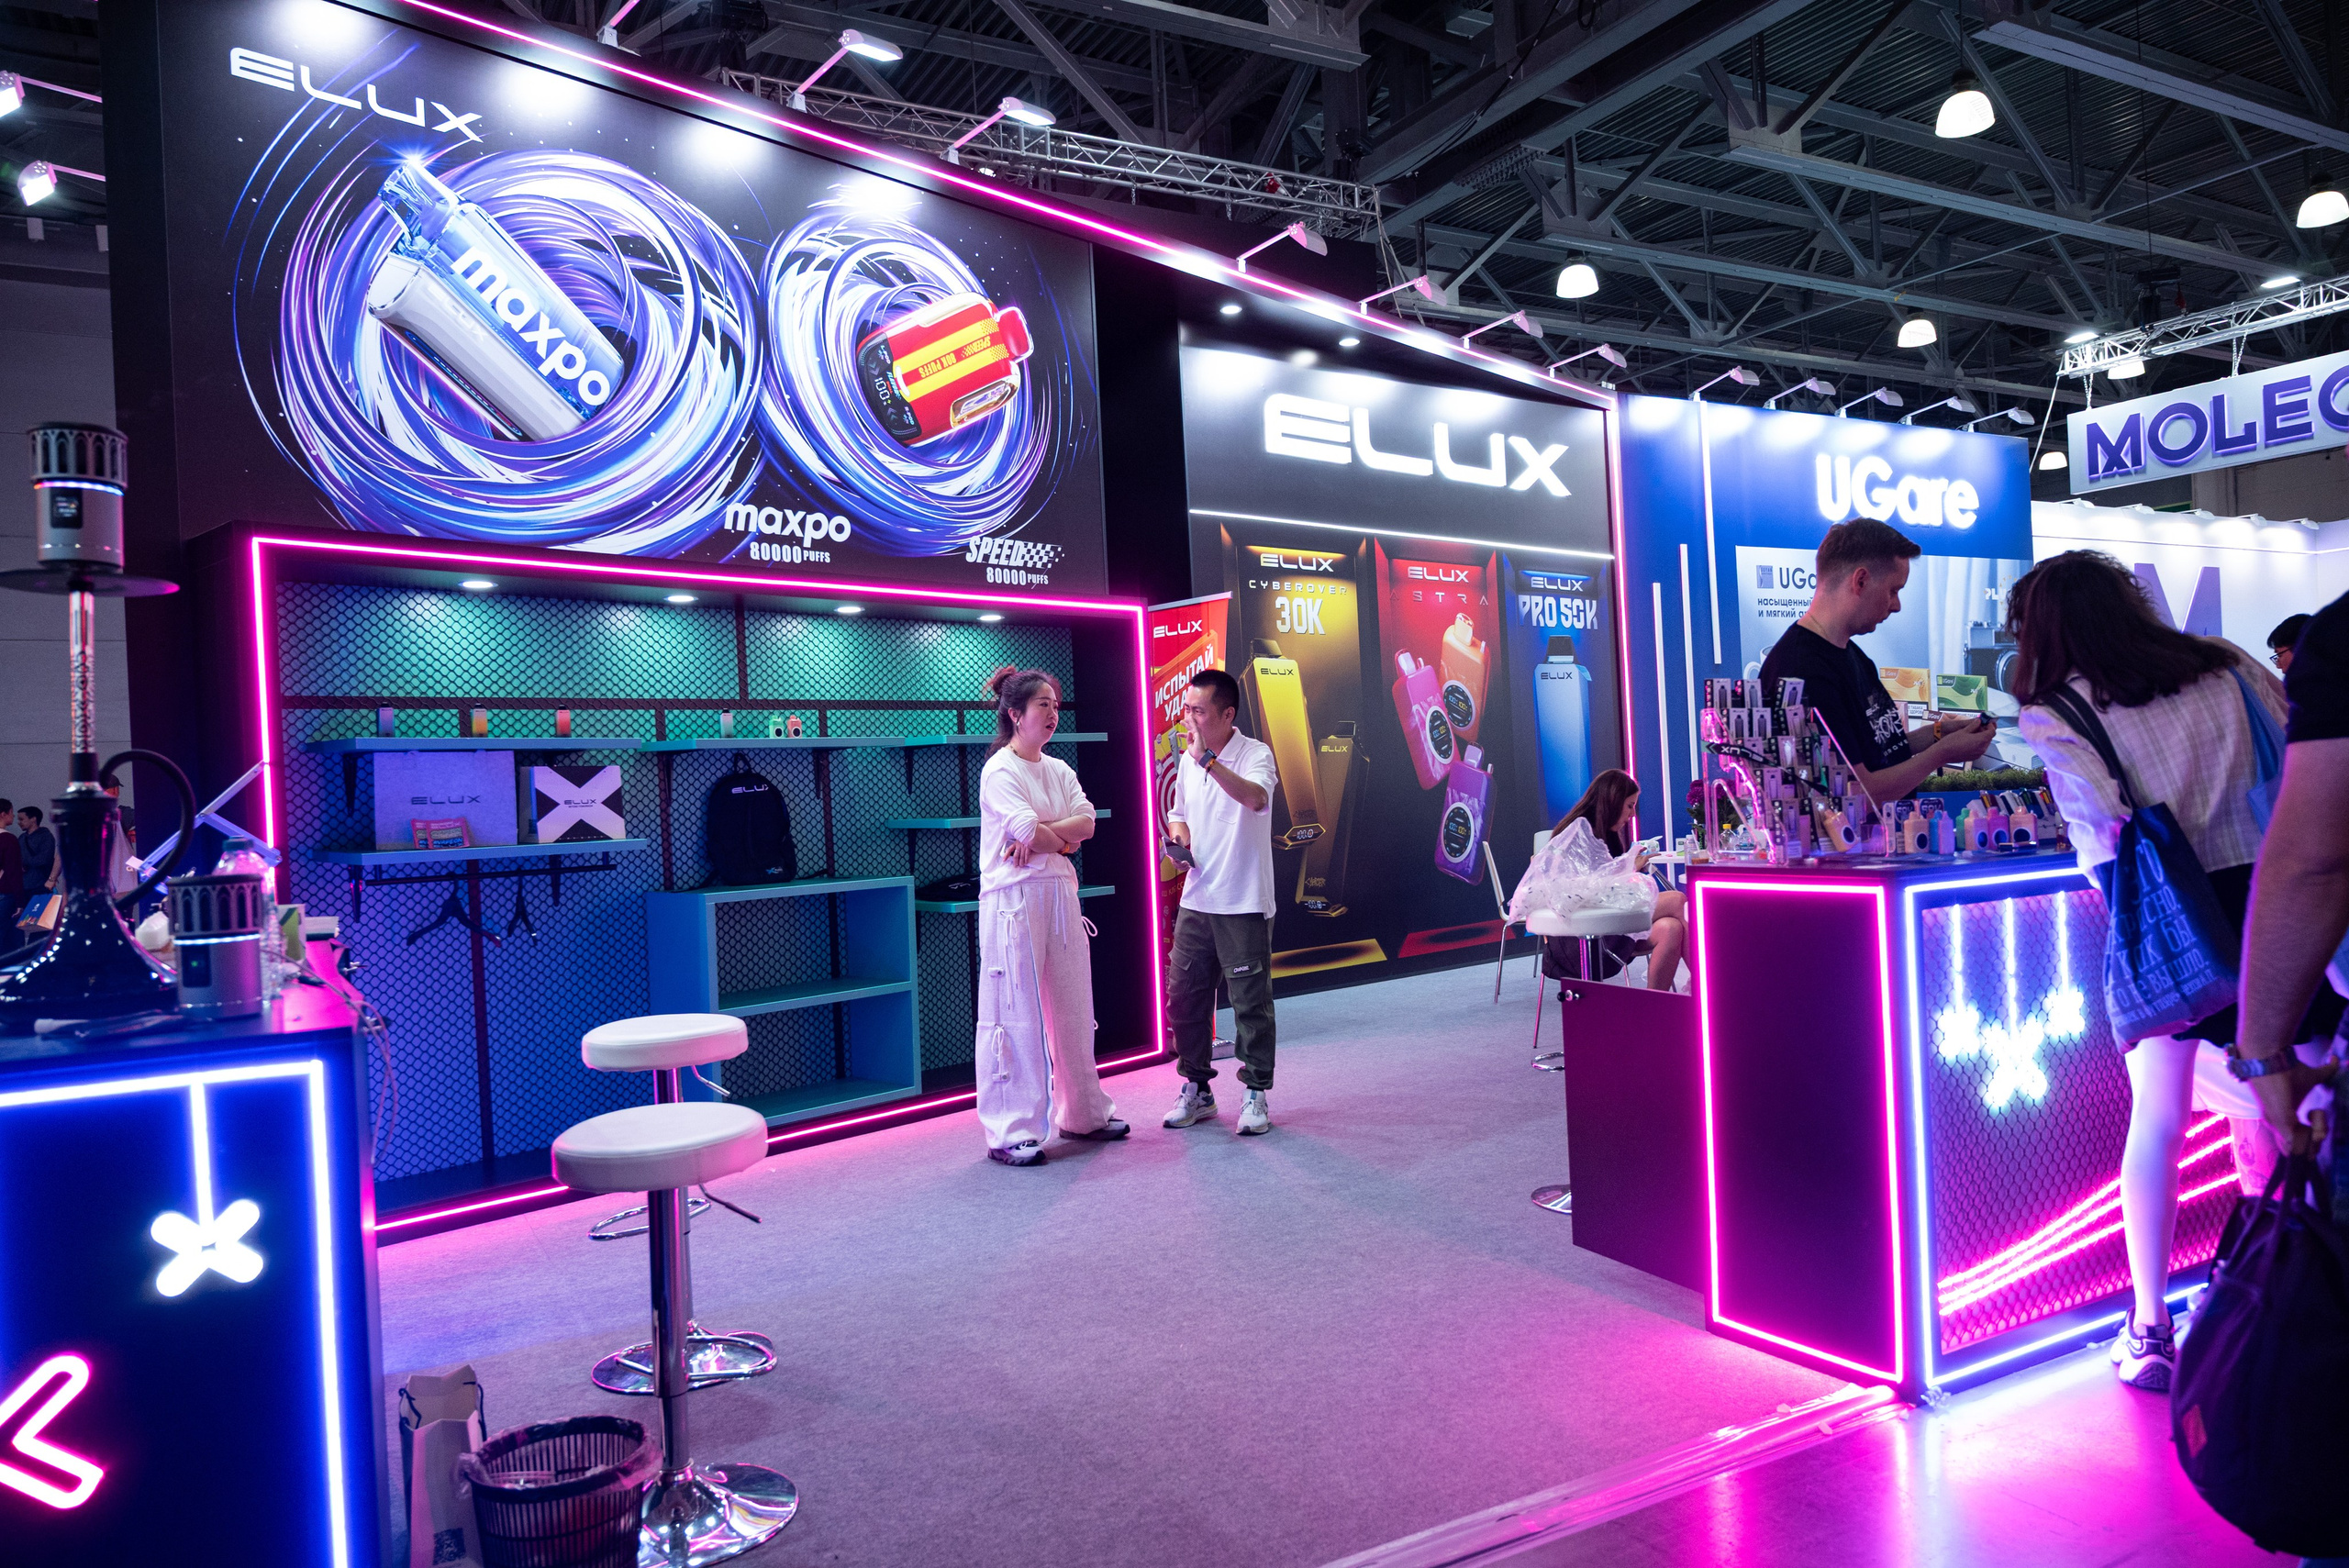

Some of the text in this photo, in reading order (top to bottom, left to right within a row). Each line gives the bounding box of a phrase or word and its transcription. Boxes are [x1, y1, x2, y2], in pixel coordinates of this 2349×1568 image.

[230, 47, 484, 143] ELUX
[450, 247, 610, 406] maxpo
[1264, 393, 1572, 497] ELUX
[1816, 453, 1979, 529] UGare
[723, 500, 852, 548] maxpo
[750, 541, 830, 564] 80000 PUFFS
[965, 536, 1027, 567] SPEED
[1260, 552, 1334, 573] ELUX
[986, 567, 1049, 585] 80000 PUFFS
[1408, 566, 1470, 584] ELUX
[1530, 575, 1584, 592] ELUX
[1779, 567, 1817, 589] UGa
[1248, 579, 1348, 595] CYBEROVER
[1389, 590, 1489, 606] ASTRA
[1275, 596, 1326, 635] 30K
[1519, 595, 1558, 628] PRO
[1765, 607, 1796, 617] мягкий
[1153, 620, 1202, 638] ELUX
[1154, 643, 1213, 708] ИСПЫТАЙ
[1260, 668, 1295, 676] ELUX
[1541, 672, 1573, 680] ELUX
[1164, 685, 1192, 721] УДА
[1320, 745, 1348, 753] ELUX
[411, 795, 481, 806] ELUX
[2160, 915, 2197, 951] БЫ
